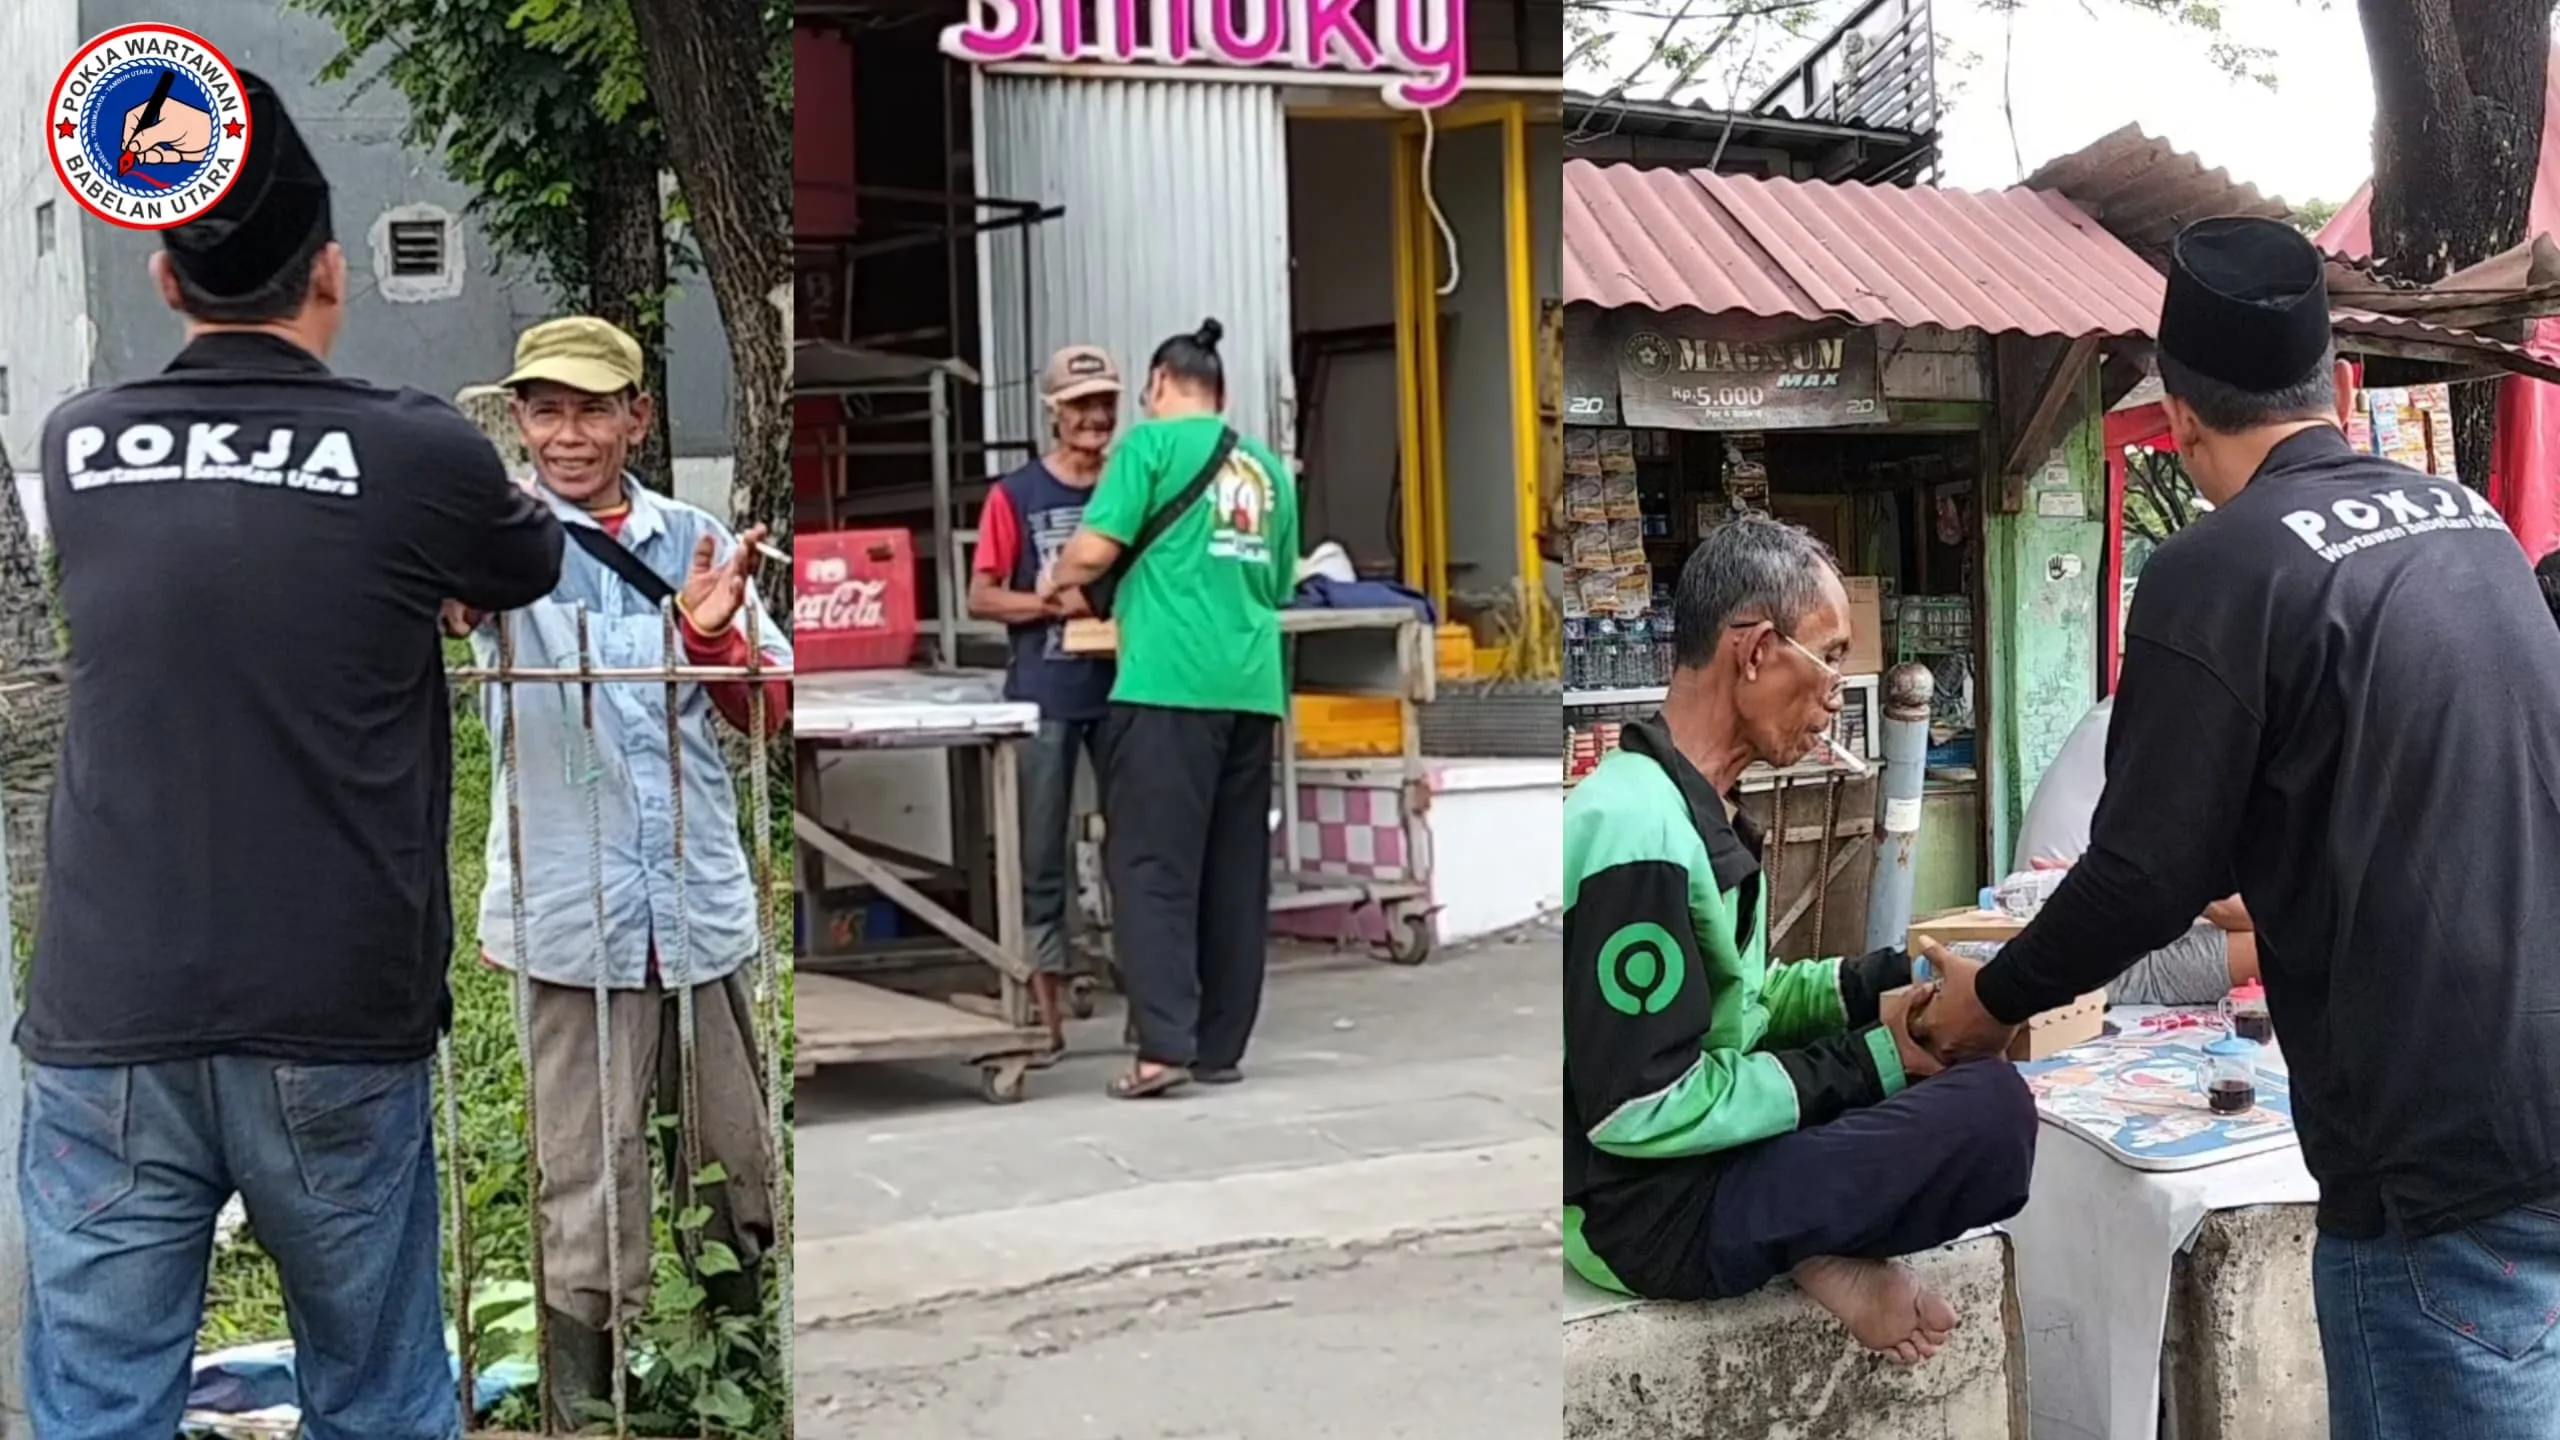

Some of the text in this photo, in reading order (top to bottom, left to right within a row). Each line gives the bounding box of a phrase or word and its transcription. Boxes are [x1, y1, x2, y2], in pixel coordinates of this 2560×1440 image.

[1676, 337, 1845, 372] MAGNUM
[1776, 373, 1840, 388] MAX
[67, 423, 360, 478] POKJA
[2281, 484, 2504, 550] POKJA
[2317, 526, 2407, 563] Wartawan
